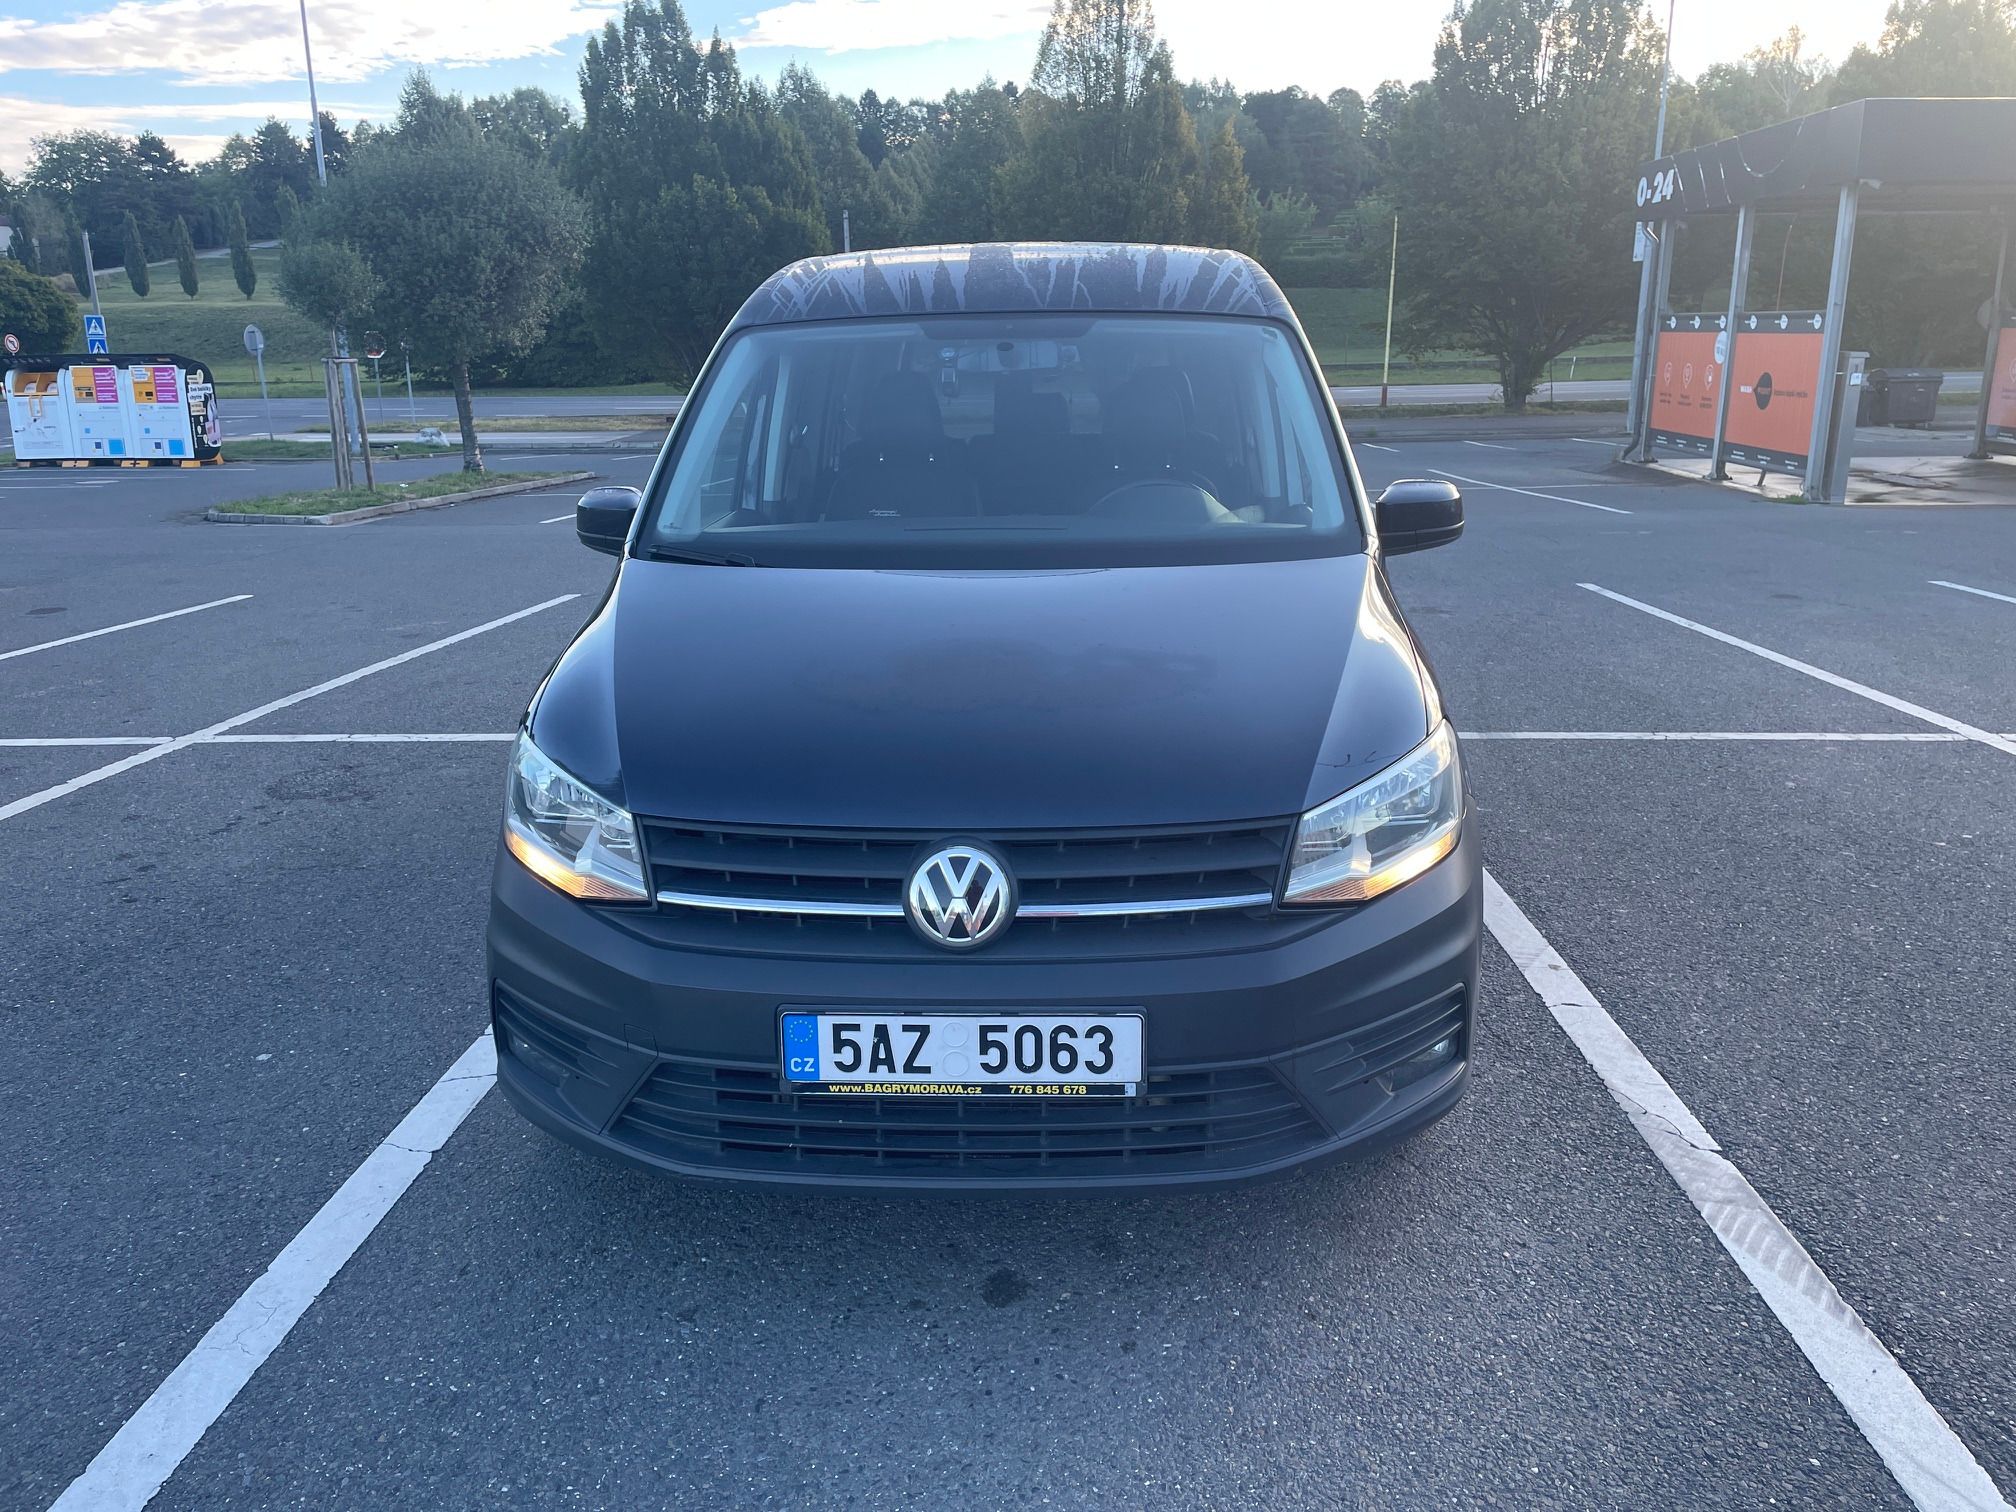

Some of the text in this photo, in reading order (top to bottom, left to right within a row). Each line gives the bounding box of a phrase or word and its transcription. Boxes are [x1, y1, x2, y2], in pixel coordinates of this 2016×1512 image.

[1636, 168, 1675, 208] 0-24
[912, 848, 1008, 945] VW
[789, 1057, 816, 1073] CZ
[831, 1023, 1115, 1075] 5AZ 5063
[828, 1083, 1087, 1096] www.BAGRYMORAVA.cz 776 845 678
